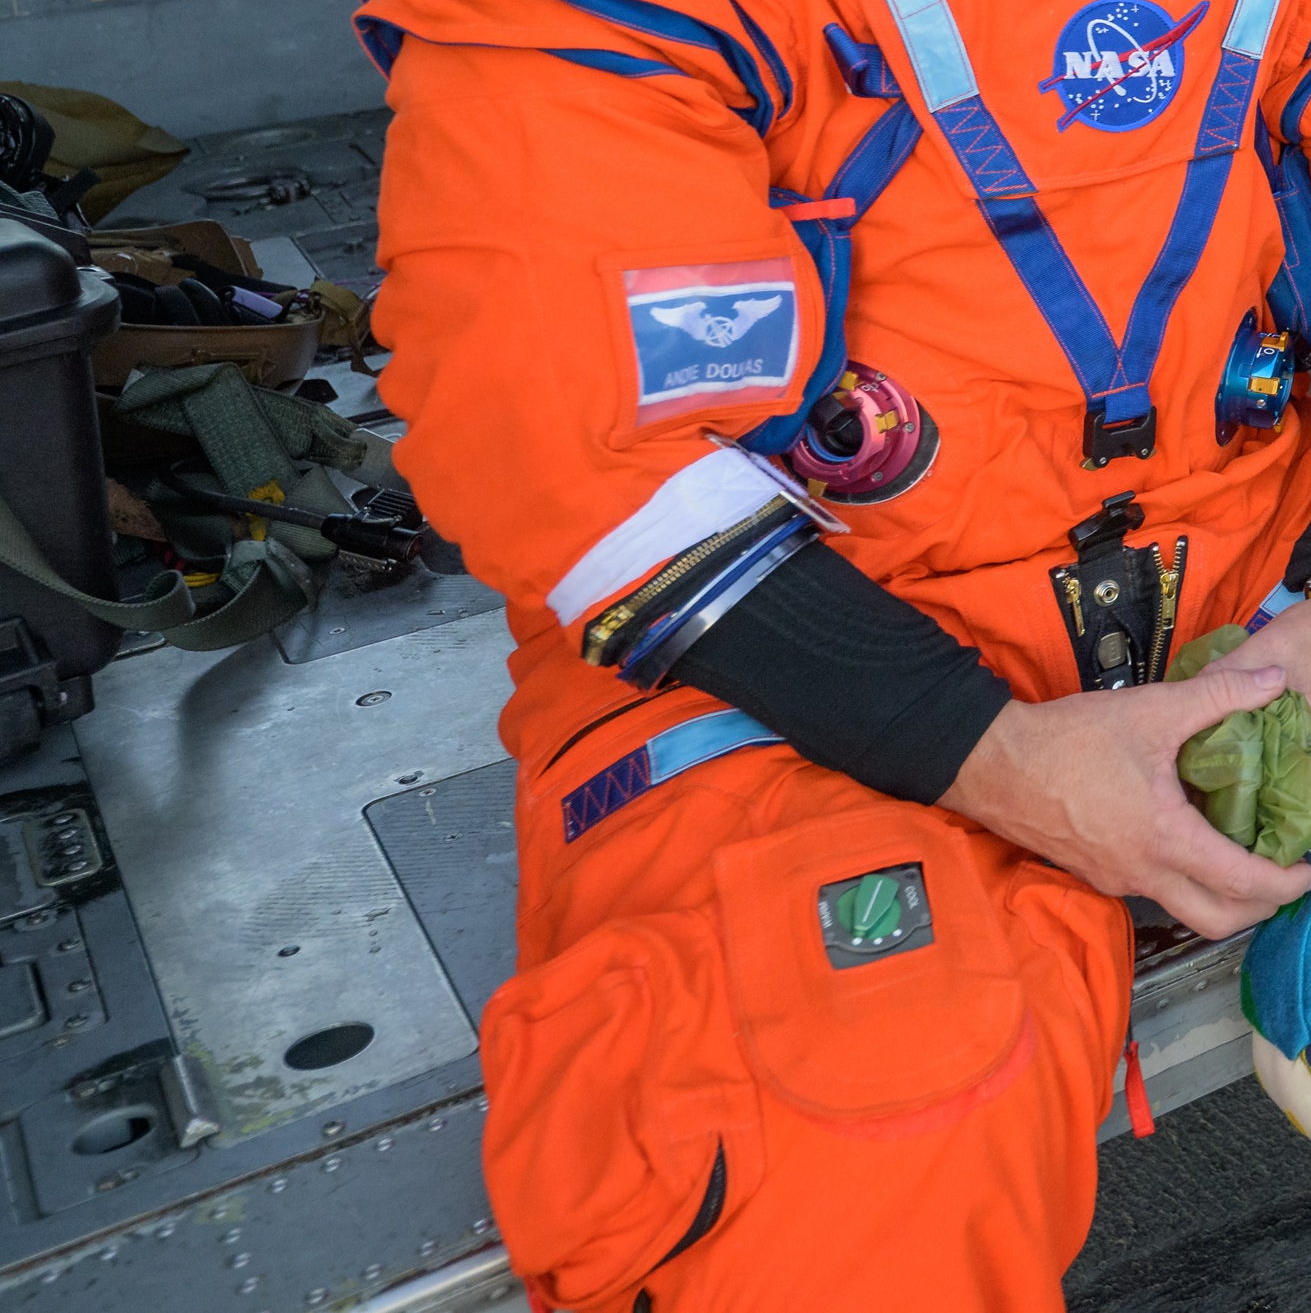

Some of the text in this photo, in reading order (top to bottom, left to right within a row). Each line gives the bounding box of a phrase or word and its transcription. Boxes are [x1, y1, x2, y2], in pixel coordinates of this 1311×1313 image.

[1063, 51, 1176, 79] NASA
[705, 358, 764, 379] DOUAS
[904, 885, 919, 910] COOL
